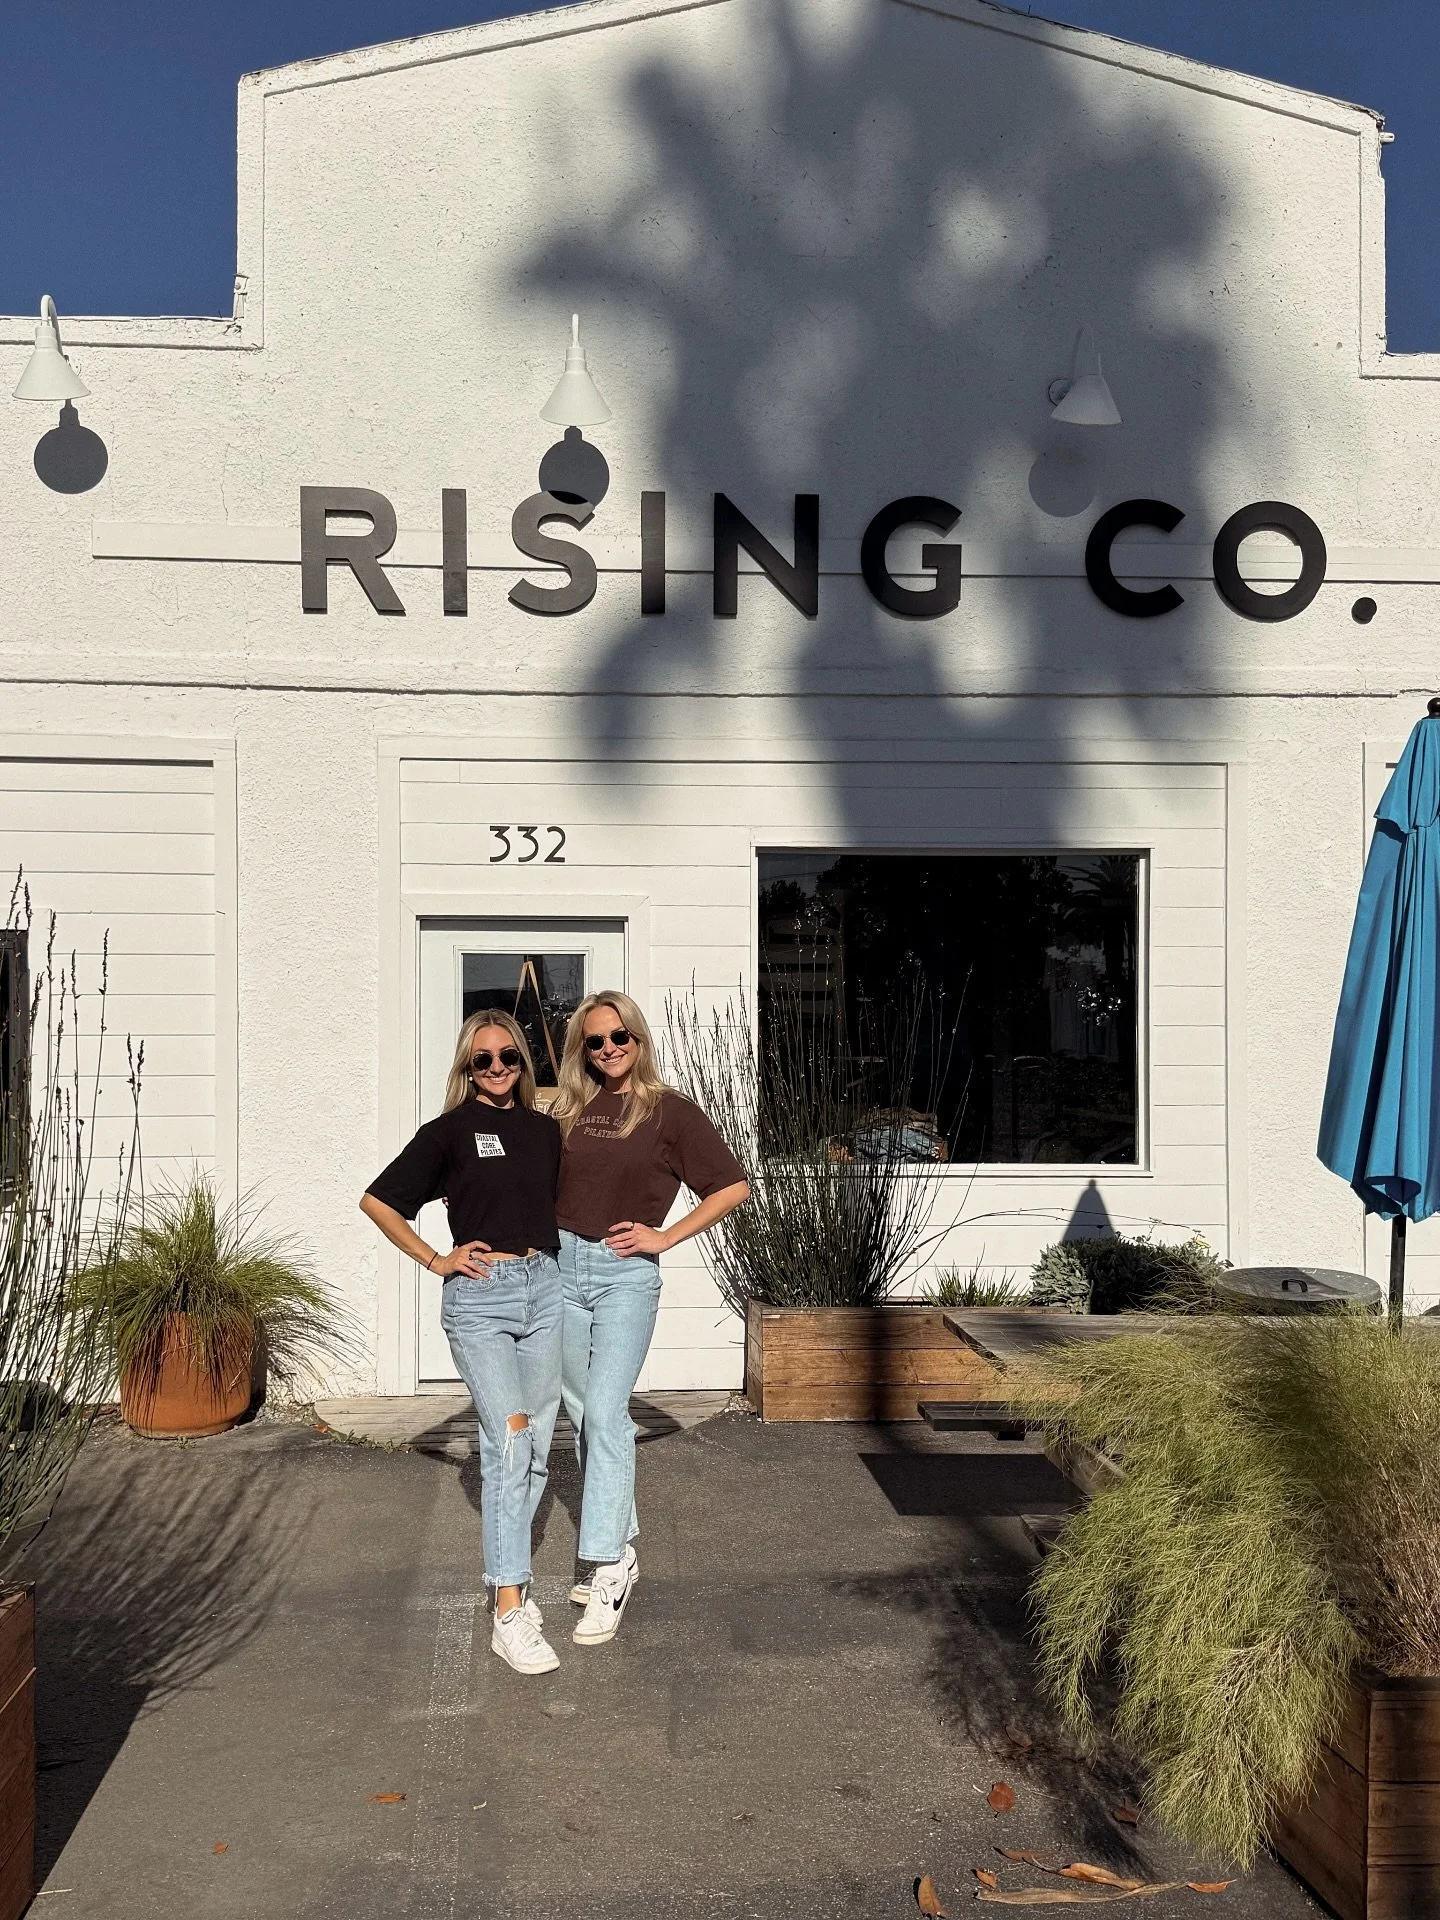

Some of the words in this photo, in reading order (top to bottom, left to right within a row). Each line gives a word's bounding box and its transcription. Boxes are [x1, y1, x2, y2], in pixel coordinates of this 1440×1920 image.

[300, 486, 962, 620] RISING
[1085, 499, 1377, 624] CO.
[489, 825, 566, 863] 332
[576, 1115, 610, 1127] COASTAL
[475, 1133, 498, 1142] COASTAL
